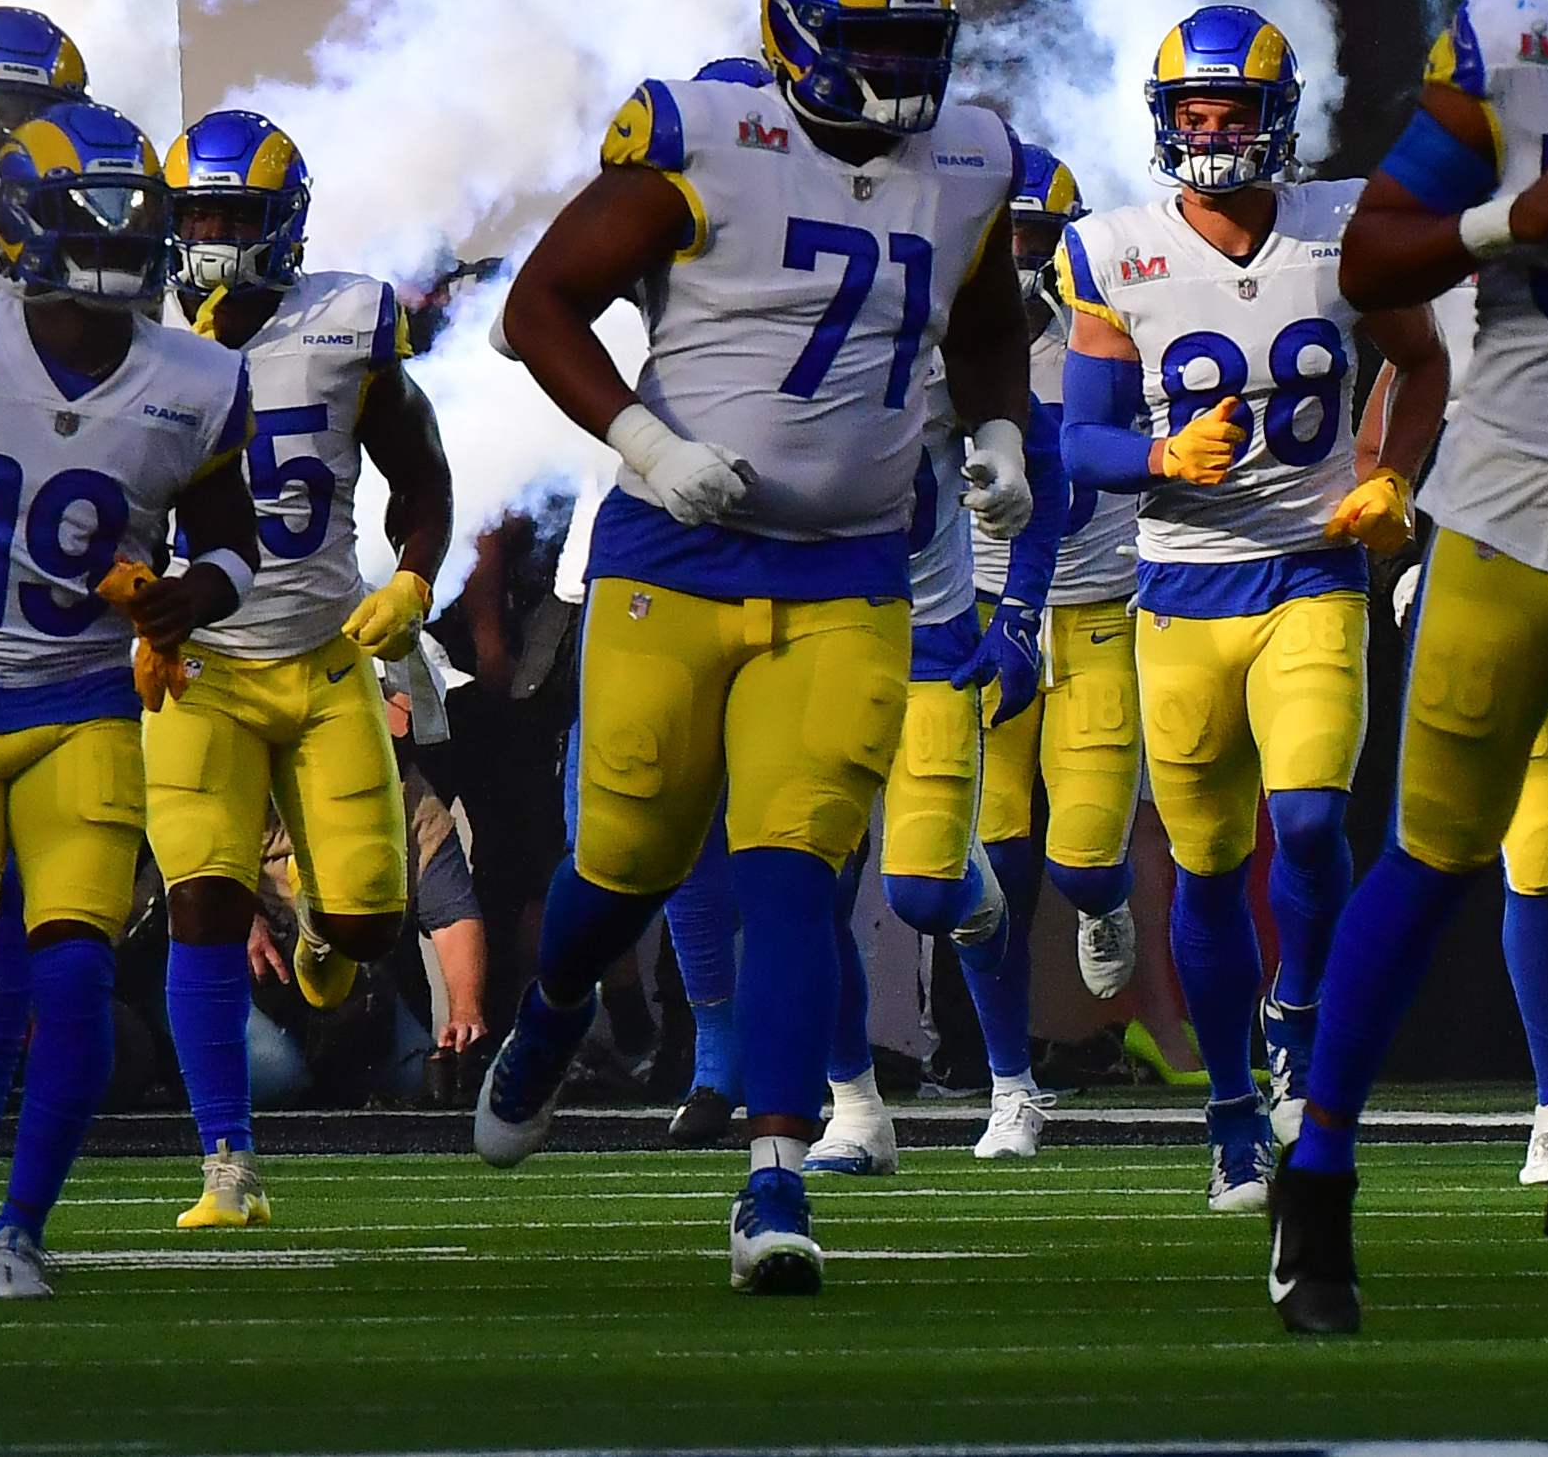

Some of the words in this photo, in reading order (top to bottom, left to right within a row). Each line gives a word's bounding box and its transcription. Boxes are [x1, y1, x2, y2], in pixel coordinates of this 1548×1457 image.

[938, 155, 985, 167] RAMS
[303, 335, 353, 345] RAMS
[782, 217, 933, 409] 71
[143, 404, 197, 425] RAMS
[1160, 318, 1347, 467] 88
[245, 404, 336, 560] 5
